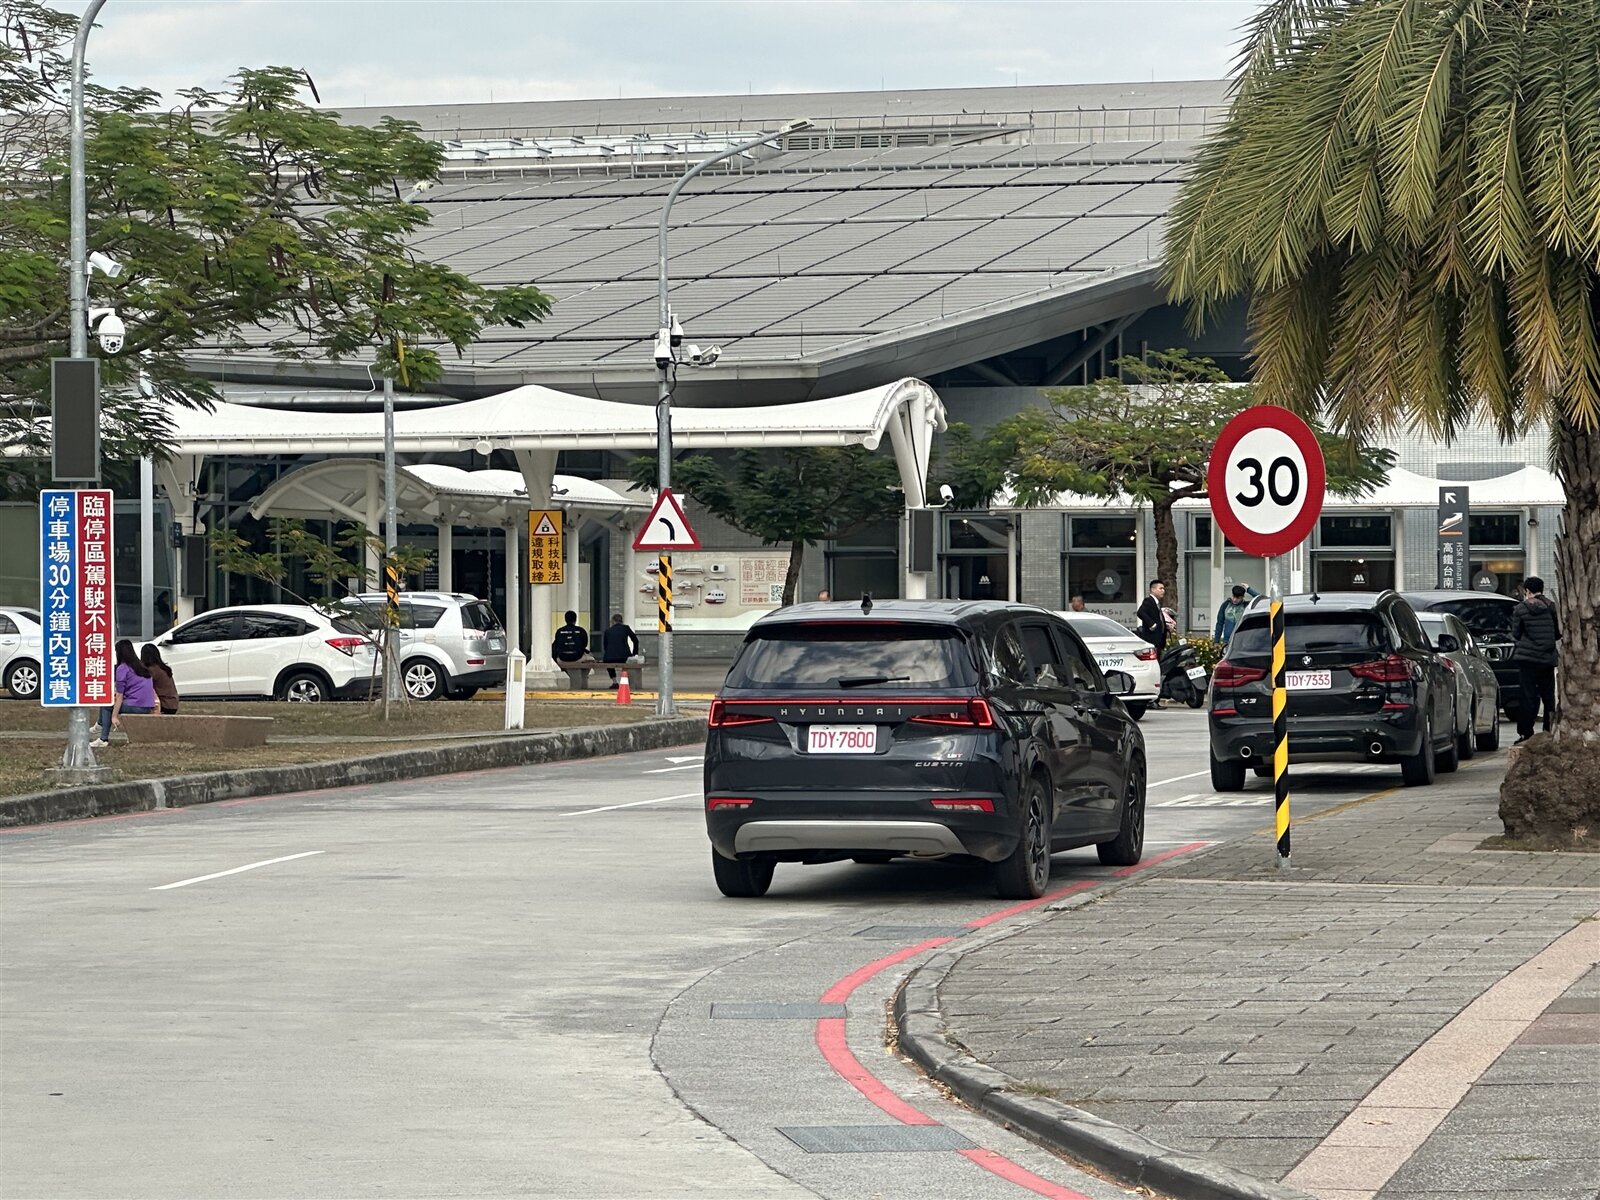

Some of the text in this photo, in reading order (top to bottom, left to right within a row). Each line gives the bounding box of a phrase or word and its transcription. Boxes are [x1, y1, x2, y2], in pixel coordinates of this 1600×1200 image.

[1236, 456, 1300, 507] 30
[531, 537, 544, 582] 違規取締
[547, 537, 561, 582] 科技執法
[1442, 542, 1454, 590] 高鐵台南
[48, 495, 71, 701] 停車場30分鐘內免費
[83, 495, 106, 701] 臨停區駕駛不得離車
[780, 708, 903, 716] HYUNDAI
